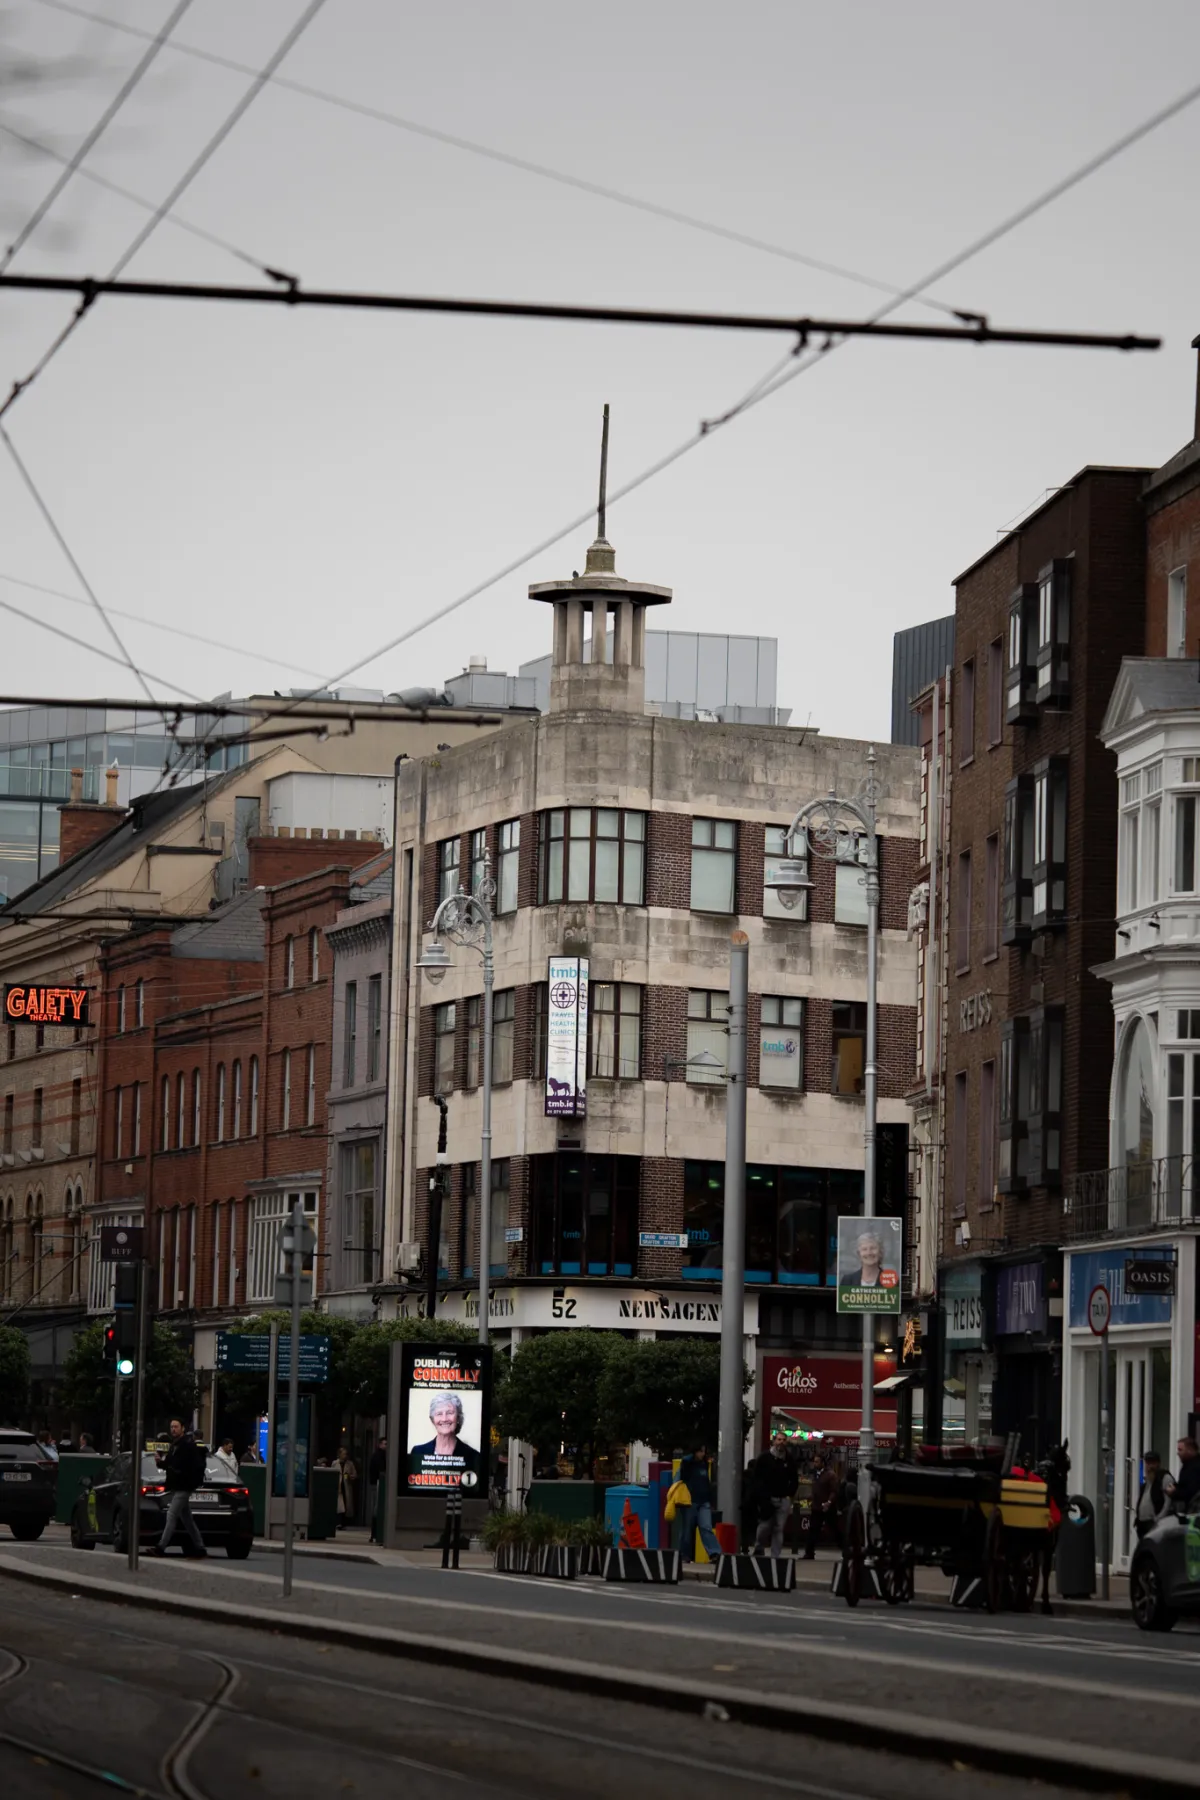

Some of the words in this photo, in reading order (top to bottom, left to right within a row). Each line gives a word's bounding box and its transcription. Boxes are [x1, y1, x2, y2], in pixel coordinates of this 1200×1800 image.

[551, 967, 577, 978] tmb
[7, 987, 87, 1019] GAIETY
[29, 1014, 62, 1022] THEATRE
[960, 989, 993, 1033] REISS
[763, 1040, 785, 1052] tmb
[686, 1228, 709, 1241] tmb
[1131, 1272, 1170, 1283] OASIS
[842, 1293, 897, 1305] CONNOLLY
[1019, 1280, 1036, 1315] TWO
[552, 1299, 577, 1318] 52
[619, 1300, 721, 1321] NEWSAGEN
[953, 1297, 982, 1331] REISS
[414, 1358, 450, 1368] DUBLIN
[450, 1359, 461, 1369] for
[413, 1367, 480, 1383] CONNOLLY
[776, 1366, 818, 1389] Gino's
[833, 1382, 860, 1390] Authentic
[408, 1473, 461, 1487] CONNOLLY
